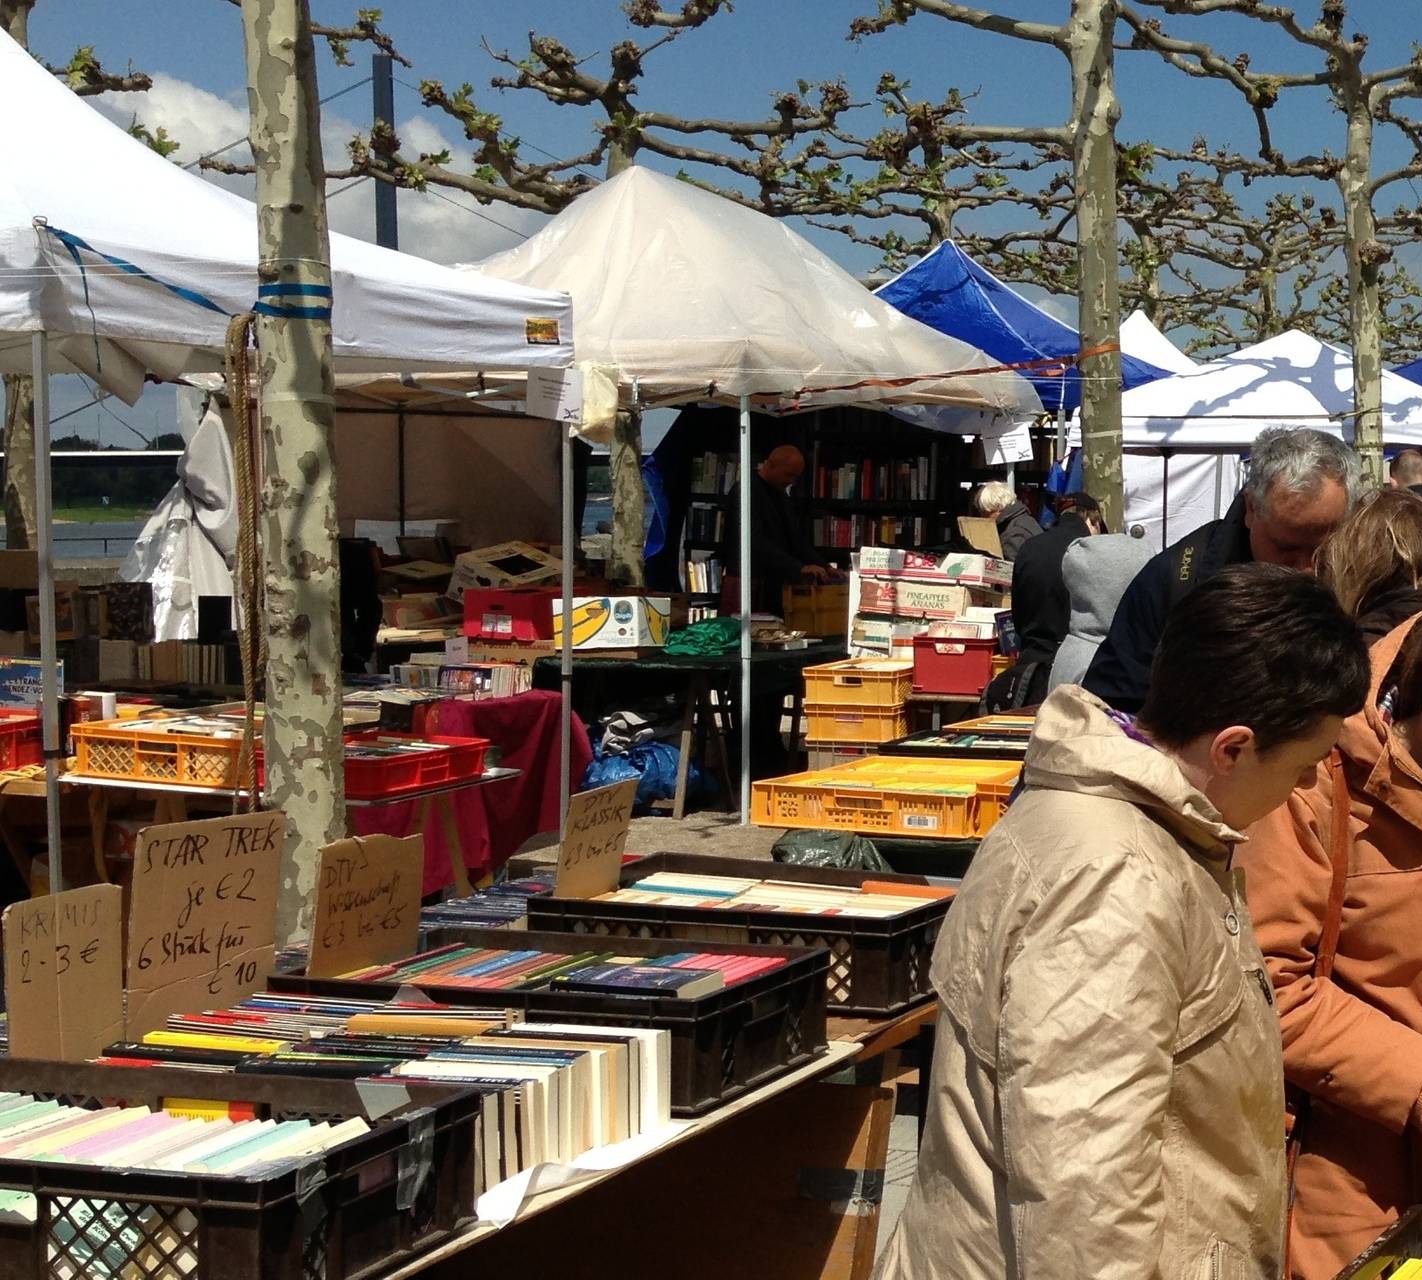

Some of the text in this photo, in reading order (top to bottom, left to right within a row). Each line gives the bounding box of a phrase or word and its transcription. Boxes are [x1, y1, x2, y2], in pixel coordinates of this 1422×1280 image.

[1180, 546, 1194, 580] DAKINE
[906, 592, 950, 602] PINEAPPLES
[911, 600, 945, 609] ANANAS
[570, 804, 628, 835] KLASSIK
[143, 819, 281, 874] STAR TREK
[177, 880, 205, 929] je
[20, 899, 102, 945] KRIMIS
[137, 937, 153, 970] 6
